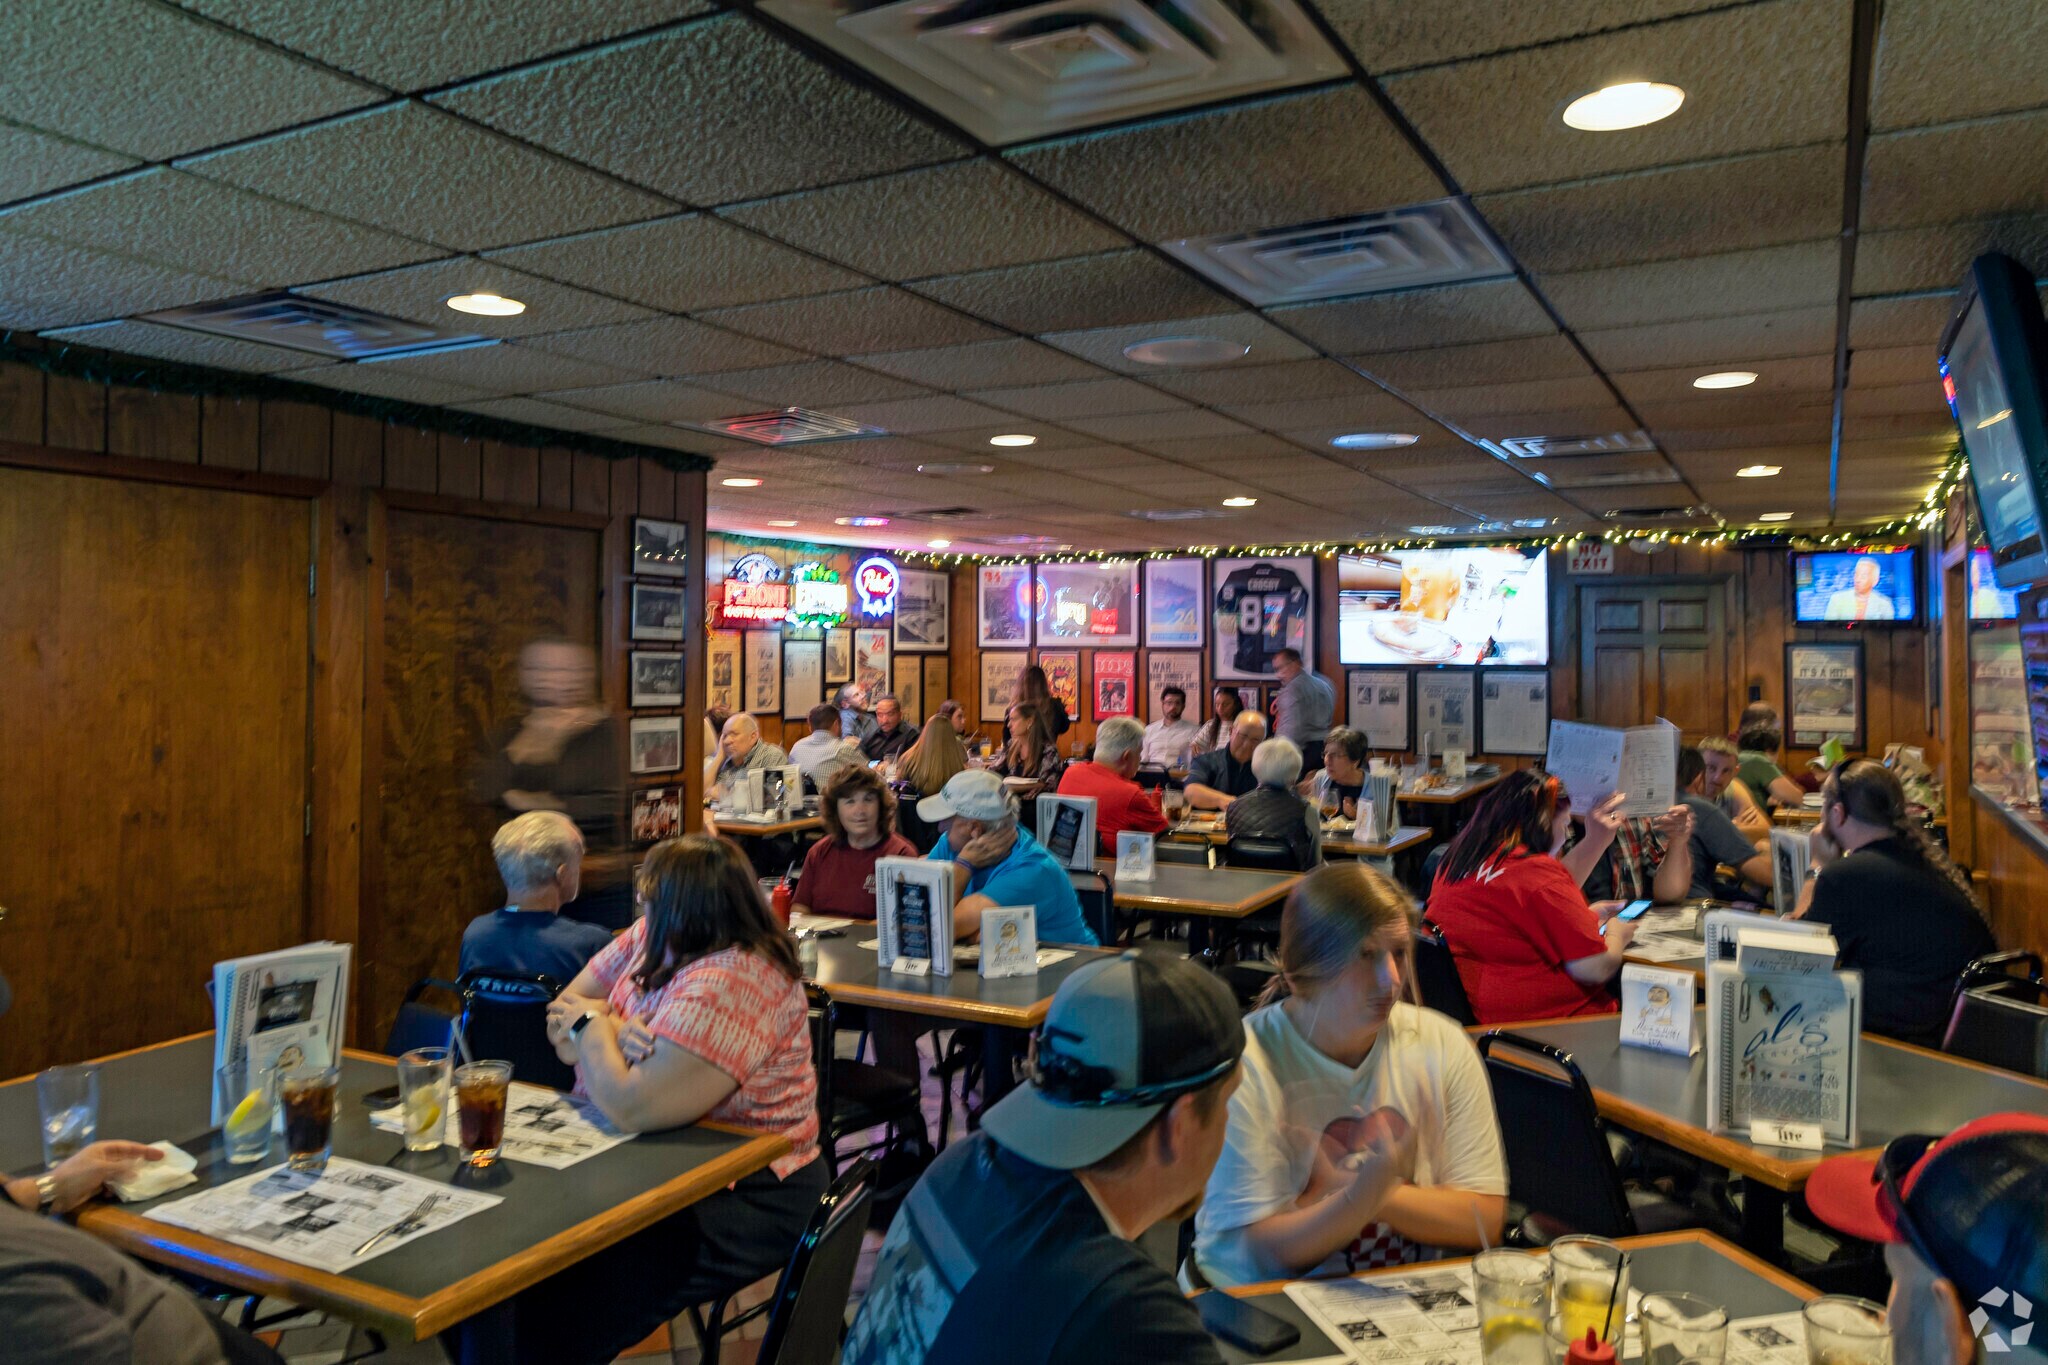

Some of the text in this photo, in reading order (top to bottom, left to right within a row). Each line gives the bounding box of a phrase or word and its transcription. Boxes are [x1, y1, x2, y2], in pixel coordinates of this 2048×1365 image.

[1579, 543, 1602, 556] NO
[1572, 558, 1608, 570] EXIT
[1247, 577, 1280, 592] CROSBY
[723, 579, 788, 607] PERONI
[1239, 595, 1287, 636] 87
[871, 634, 886, 652] 24
